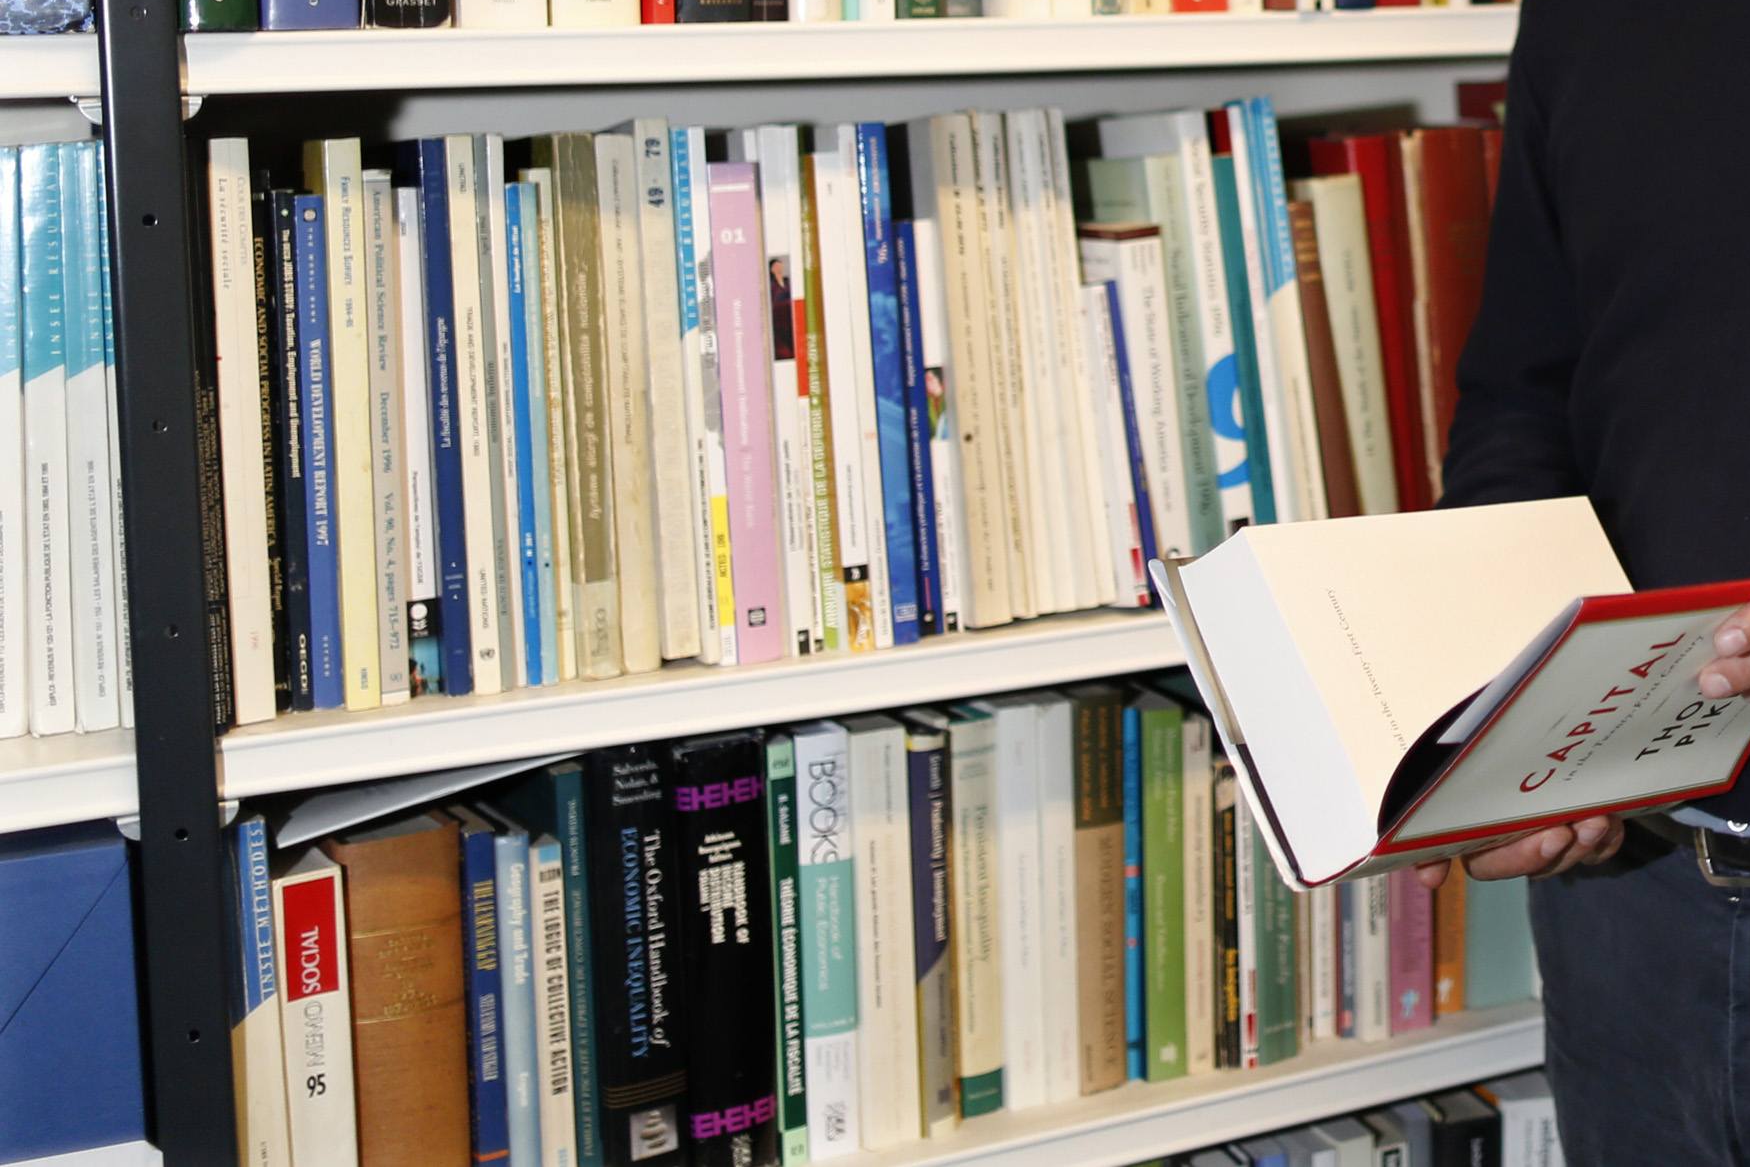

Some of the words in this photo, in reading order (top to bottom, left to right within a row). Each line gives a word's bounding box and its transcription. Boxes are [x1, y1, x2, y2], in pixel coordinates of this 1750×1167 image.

[644, 136, 661, 158] 79
[217, 178, 227, 192] La
[648, 186, 665, 208] 49
[217, 199, 230, 244] sécurité
[371, 190, 384, 240] American
[720, 228, 746, 244] 01
[219, 249, 233, 290] sociale
[252, 237, 265, 302] ECONOMIC
[374, 245, 386, 288] Political
[255, 306, 267, 333] AND
[375, 292, 387, 331] Science
[257, 337, 269, 377] SOCIAL
[308, 340, 323, 380] WORLD
[376, 336, 388, 371] Review
[259, 381, 272, 440] PROGRESS
[309, 384, 327, 467] DEVELOPMENT
[262, 443, 273, 455] IN
[262, 459, 274, 491] LATIN
[312, 470, 328, 516] REPORT
[264, 496, 277, 546] AMERICA
[314, 519, 329, 546] 1997
[1519, 632, 1686, 792] CAPITAL
[1564, 769, 1577, 782] in
[1577, 750, 1595, 767] the
[1594, 682, 1659, 747] Twenty-First
[1660, 634, 1705, 680] Century
[645, 831, 665, 866] The
[508, 862, 527, 925] Geography
[622, 827, 646, 930] ECONOMIC
[543, 891, 559, 913] THE
[646, 870, 668, 929] Oxford
[777, 878, 795, 923] THÉORIE
[513, 928, 528, 949] and
[543, 917, 560, 953] LOGIC
[299, 926, 322, 992] SOCIAL
[514, 952, 529, 985] Trade
[546, 958, 561, 970] OF
[649, 932, 673, 1021] Handbook
[778, 926, 799, 1005] ÉCONOMIQUE
[545, 974, 564, 1045] COLLECTIVE
[626, 934, 651, 1059] INEQUALITY
[784, 1007, 799, 1021] DE
[302, 1000, 327, 1067] MEMO
[651, 1025, 674, 1045] of
[785, 1023, 800, 1035] LA
[304, 1073, 328, 1098] 95
[548, 1049, 567, 1096] ACTION
[783, 1037, 804, 1094] FISCALITÉ
